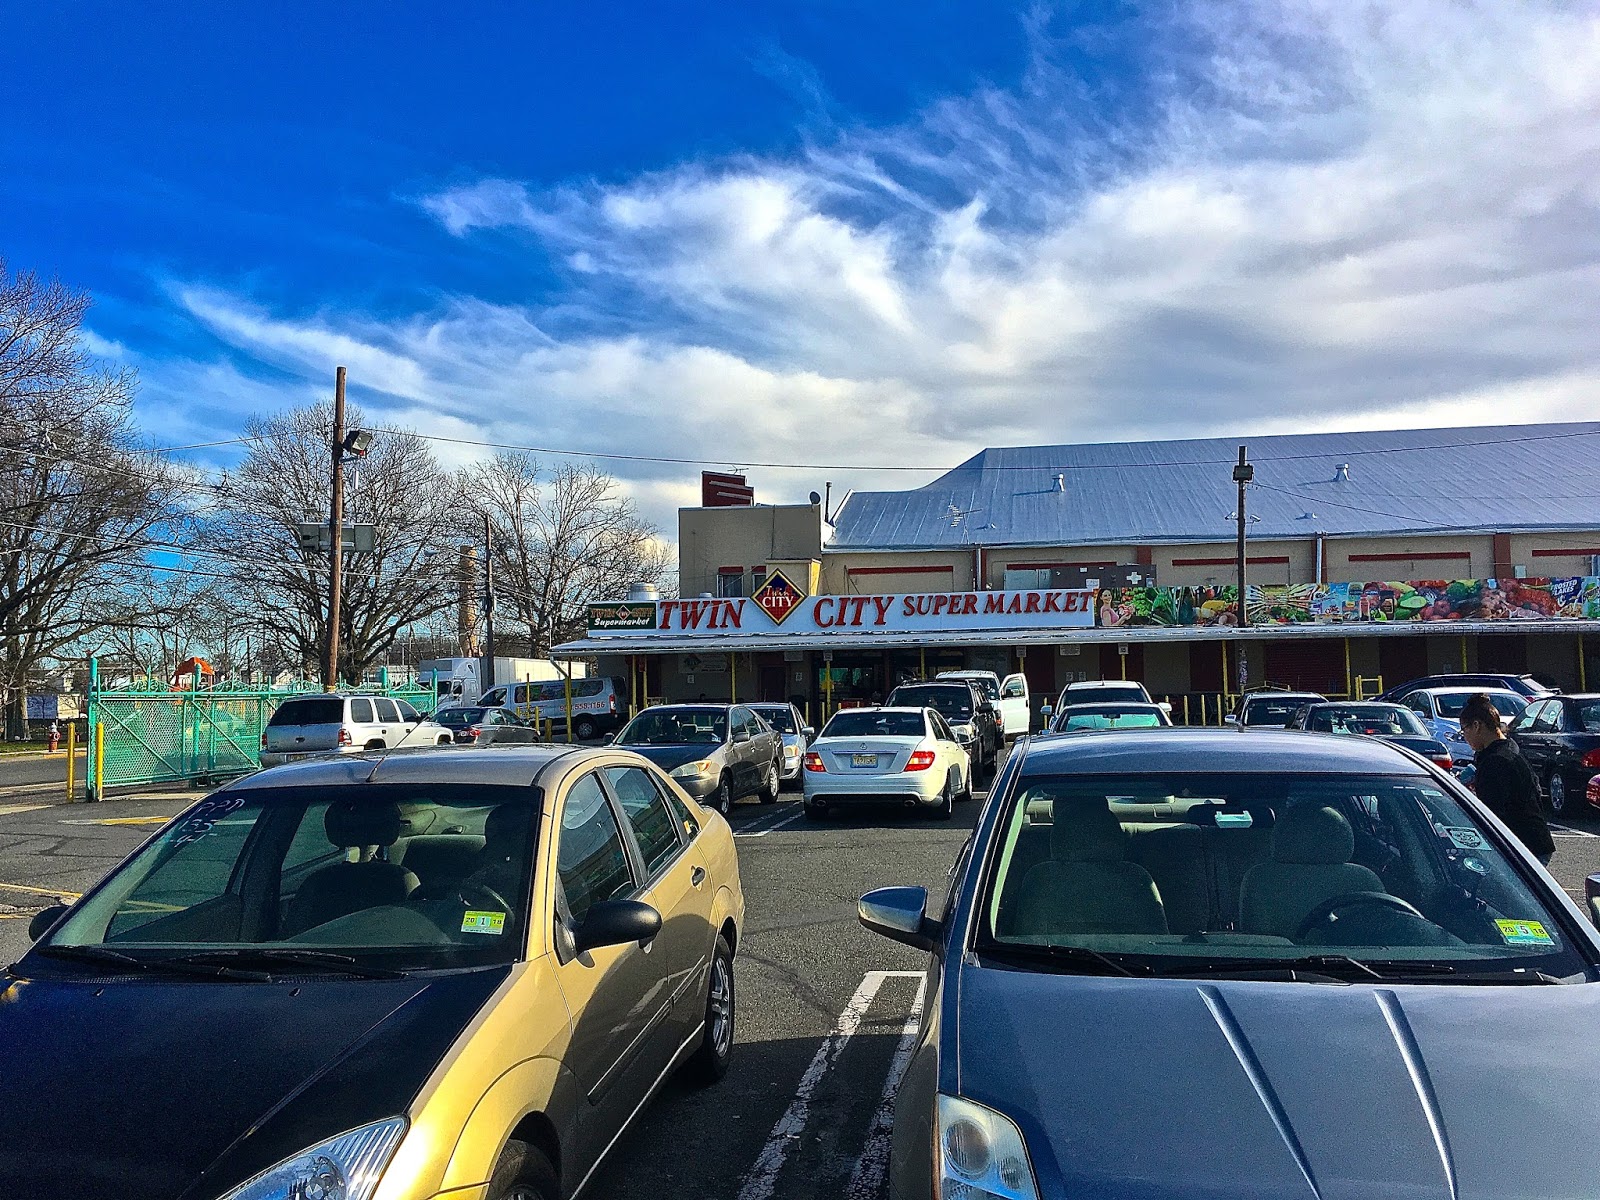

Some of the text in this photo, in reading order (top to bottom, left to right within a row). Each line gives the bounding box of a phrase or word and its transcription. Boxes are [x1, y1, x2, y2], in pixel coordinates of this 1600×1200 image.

[766, 585, 790, 598] Twin
[762, 596, 794, 608] CITY
[659, 591, 1095, 630] TWIN CITY SUPER MARKET
[594, 617, 650, 628] Supermarket
[1520, 925, 1529, 935] 5
